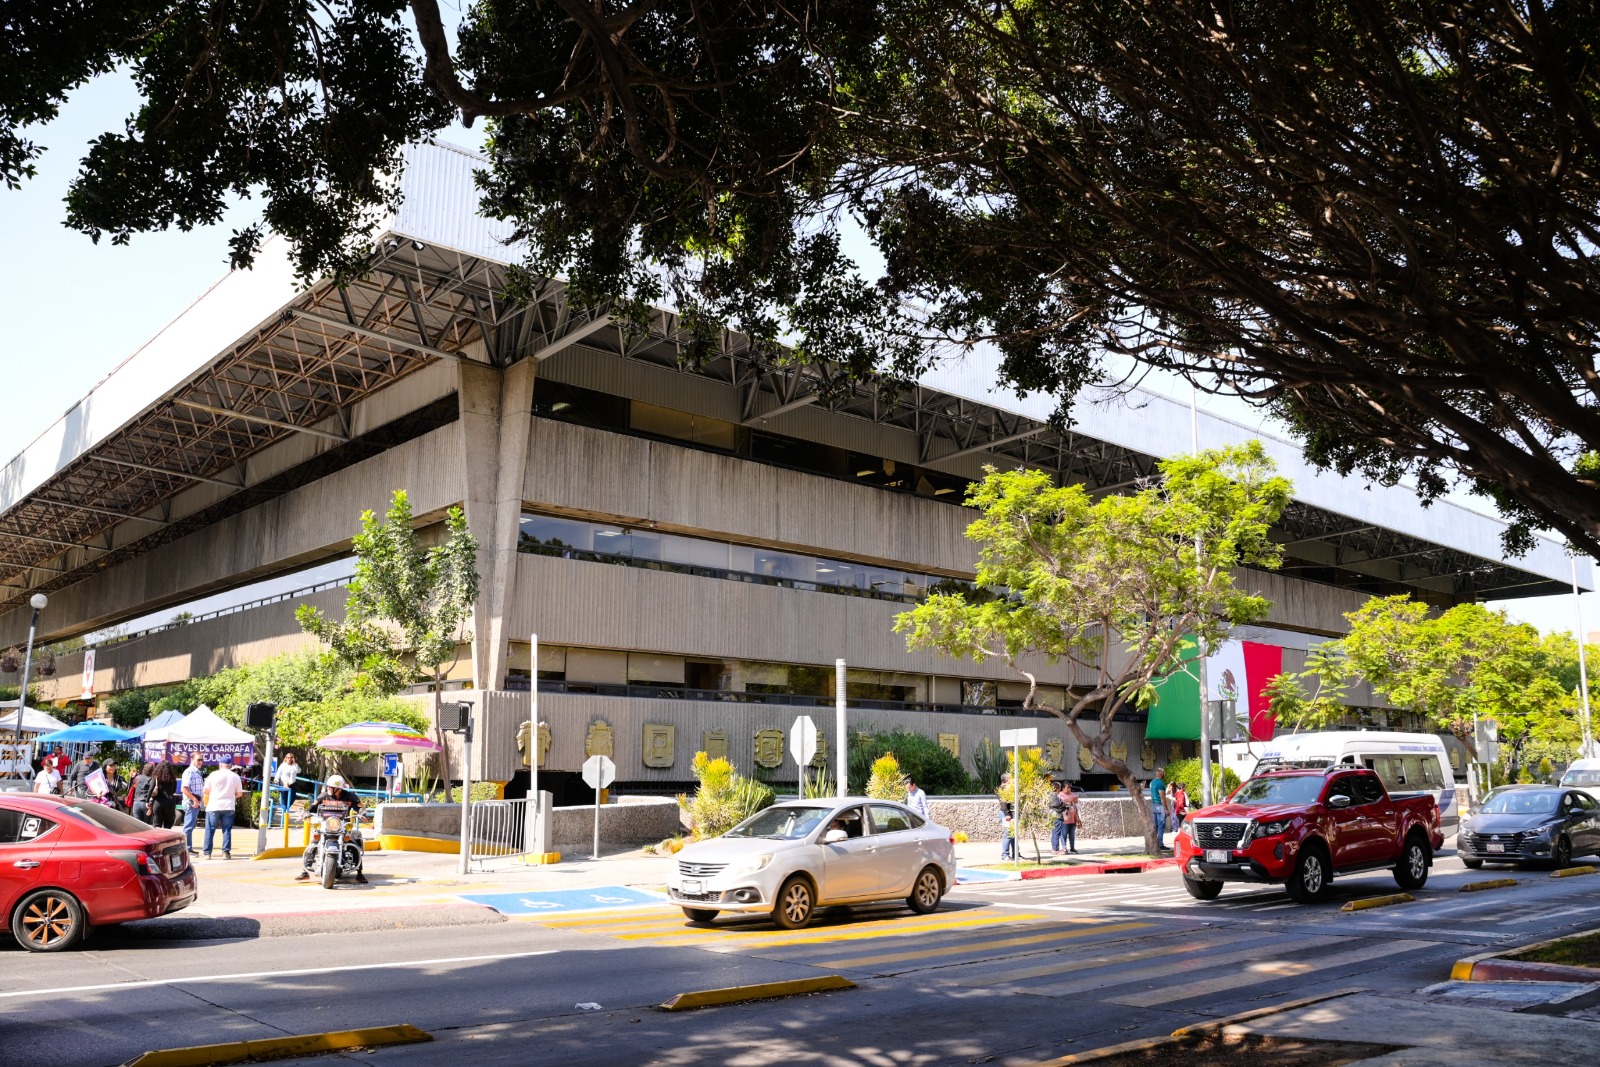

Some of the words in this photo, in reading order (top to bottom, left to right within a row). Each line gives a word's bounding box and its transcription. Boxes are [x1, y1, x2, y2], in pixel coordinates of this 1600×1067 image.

[170, 743, 198, 752] NIEVES
[199, 743, 210, 752] DE
[211, 744, 250, 753] GARRAFA
[201, 753, 232, 762] EJUINO
